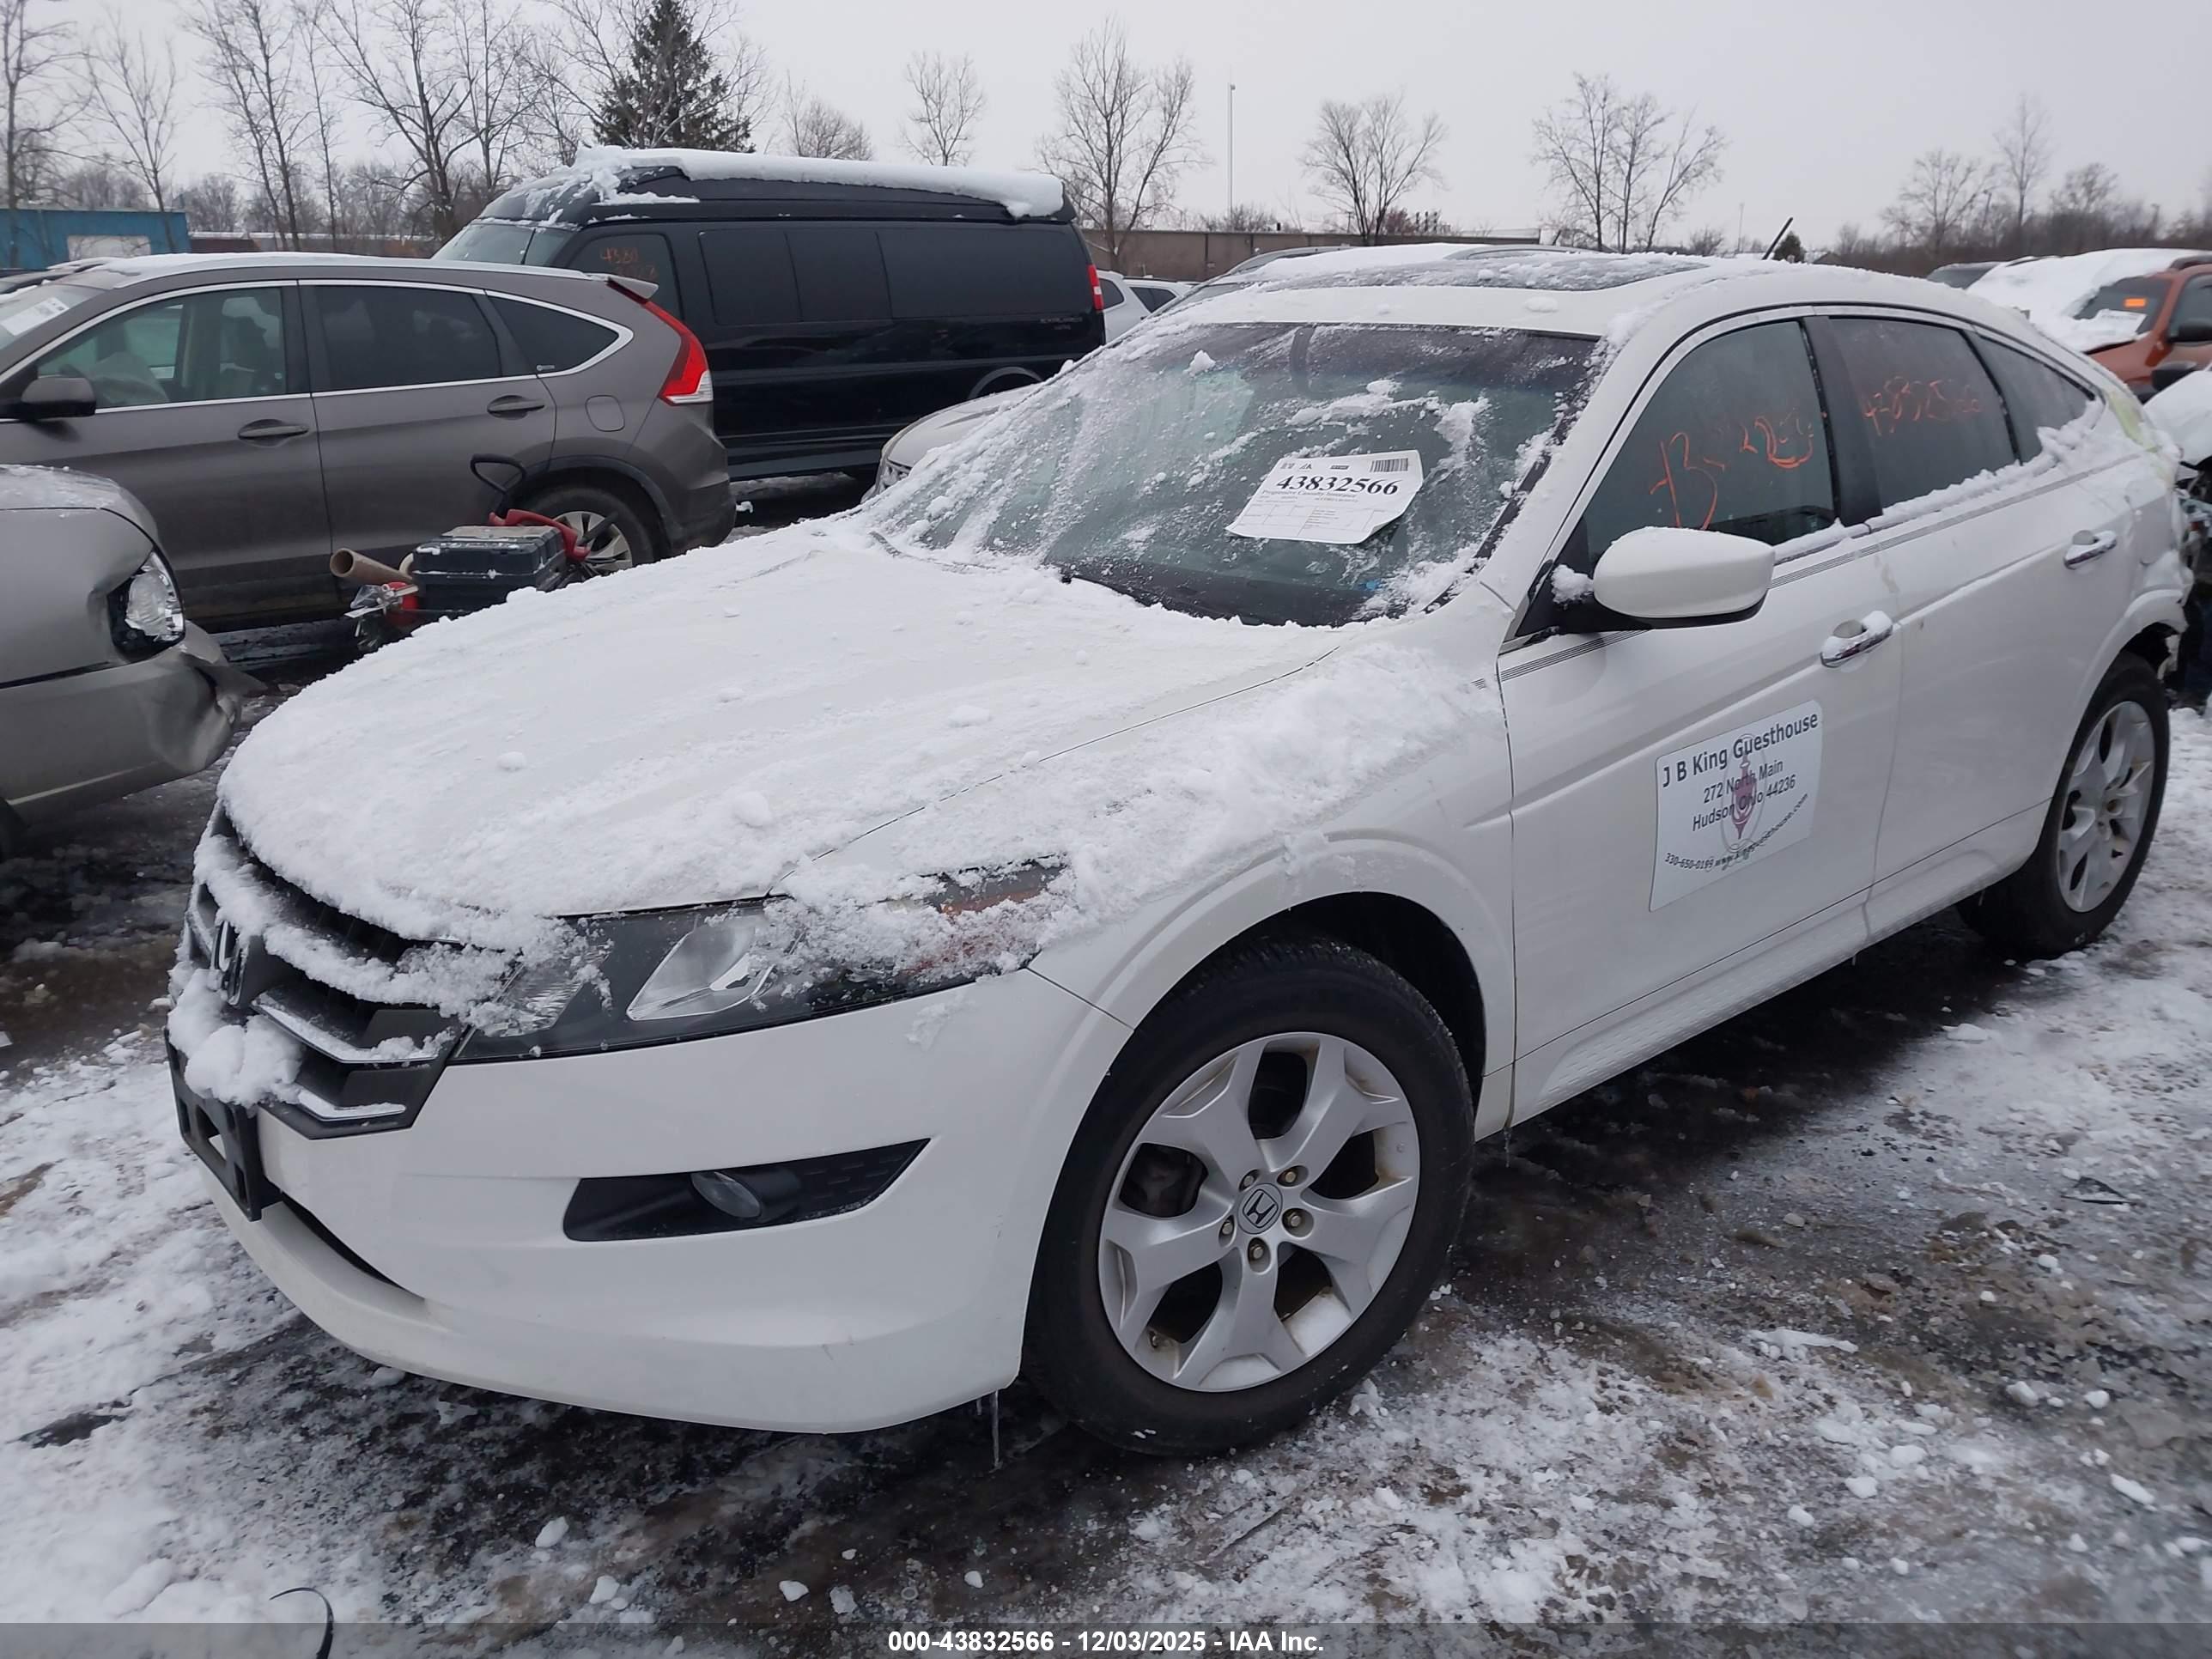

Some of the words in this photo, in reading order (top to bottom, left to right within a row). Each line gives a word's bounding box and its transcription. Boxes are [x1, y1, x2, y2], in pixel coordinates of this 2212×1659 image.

[1276, 475, 1401, 495] 43832566
[1662, 766, 1671, 788] J
[1677, 761, 1687, 782] B
[1692, 748, 1728, 776] King
[1733, 713, 1818, 759] Guesthouse
[1692, 803, 1735, 833] Hudson
[1766, 774, 1796, 799] 44236
[1704, 781, 1723, 804] 272
[1759, 759, 1784, 781] Main
